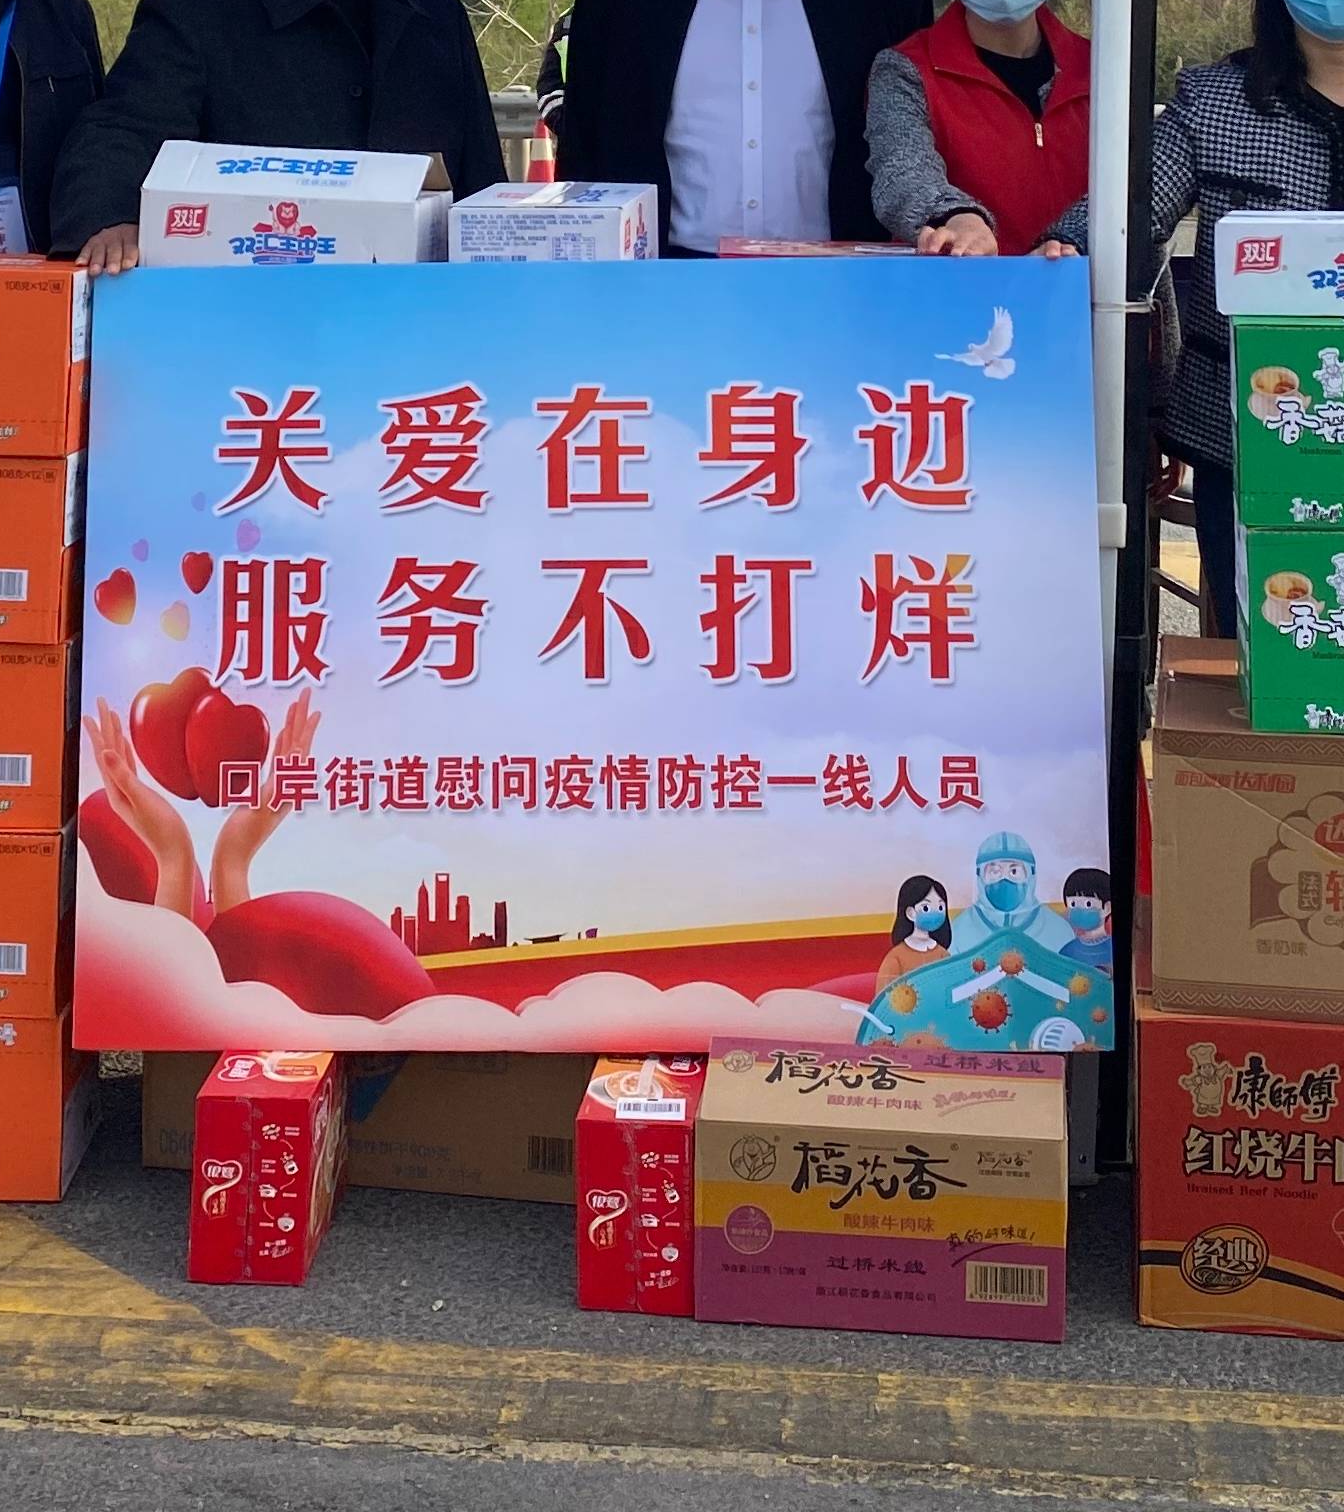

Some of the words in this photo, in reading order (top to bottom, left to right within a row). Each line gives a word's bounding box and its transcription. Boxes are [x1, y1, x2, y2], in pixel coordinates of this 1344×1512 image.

[216, 157, 357, 176] 双汇王中王
[169, 207, 203, 229] 双汇
[229, 233, 336, 256] 双汇王中王
[1240, 240, 1277, 264] 双汇
[214, 382, 972, 514] 关爱在身边
[214, 551, 978, 686] 服务不打烊
[217, 753, 985, 814] 口岸街道慰问疫情防控一线人员
[764, 1049, 926, 1094] 稻花香
[826, 1094, 922, 1111] 酸辣牛肉味
[790, 1141, 968, 1210] 稻花香
[843, 1213, 936, 1233] 酸辣牛肉味
[1193, 1236, 1257, 1272] 经典
